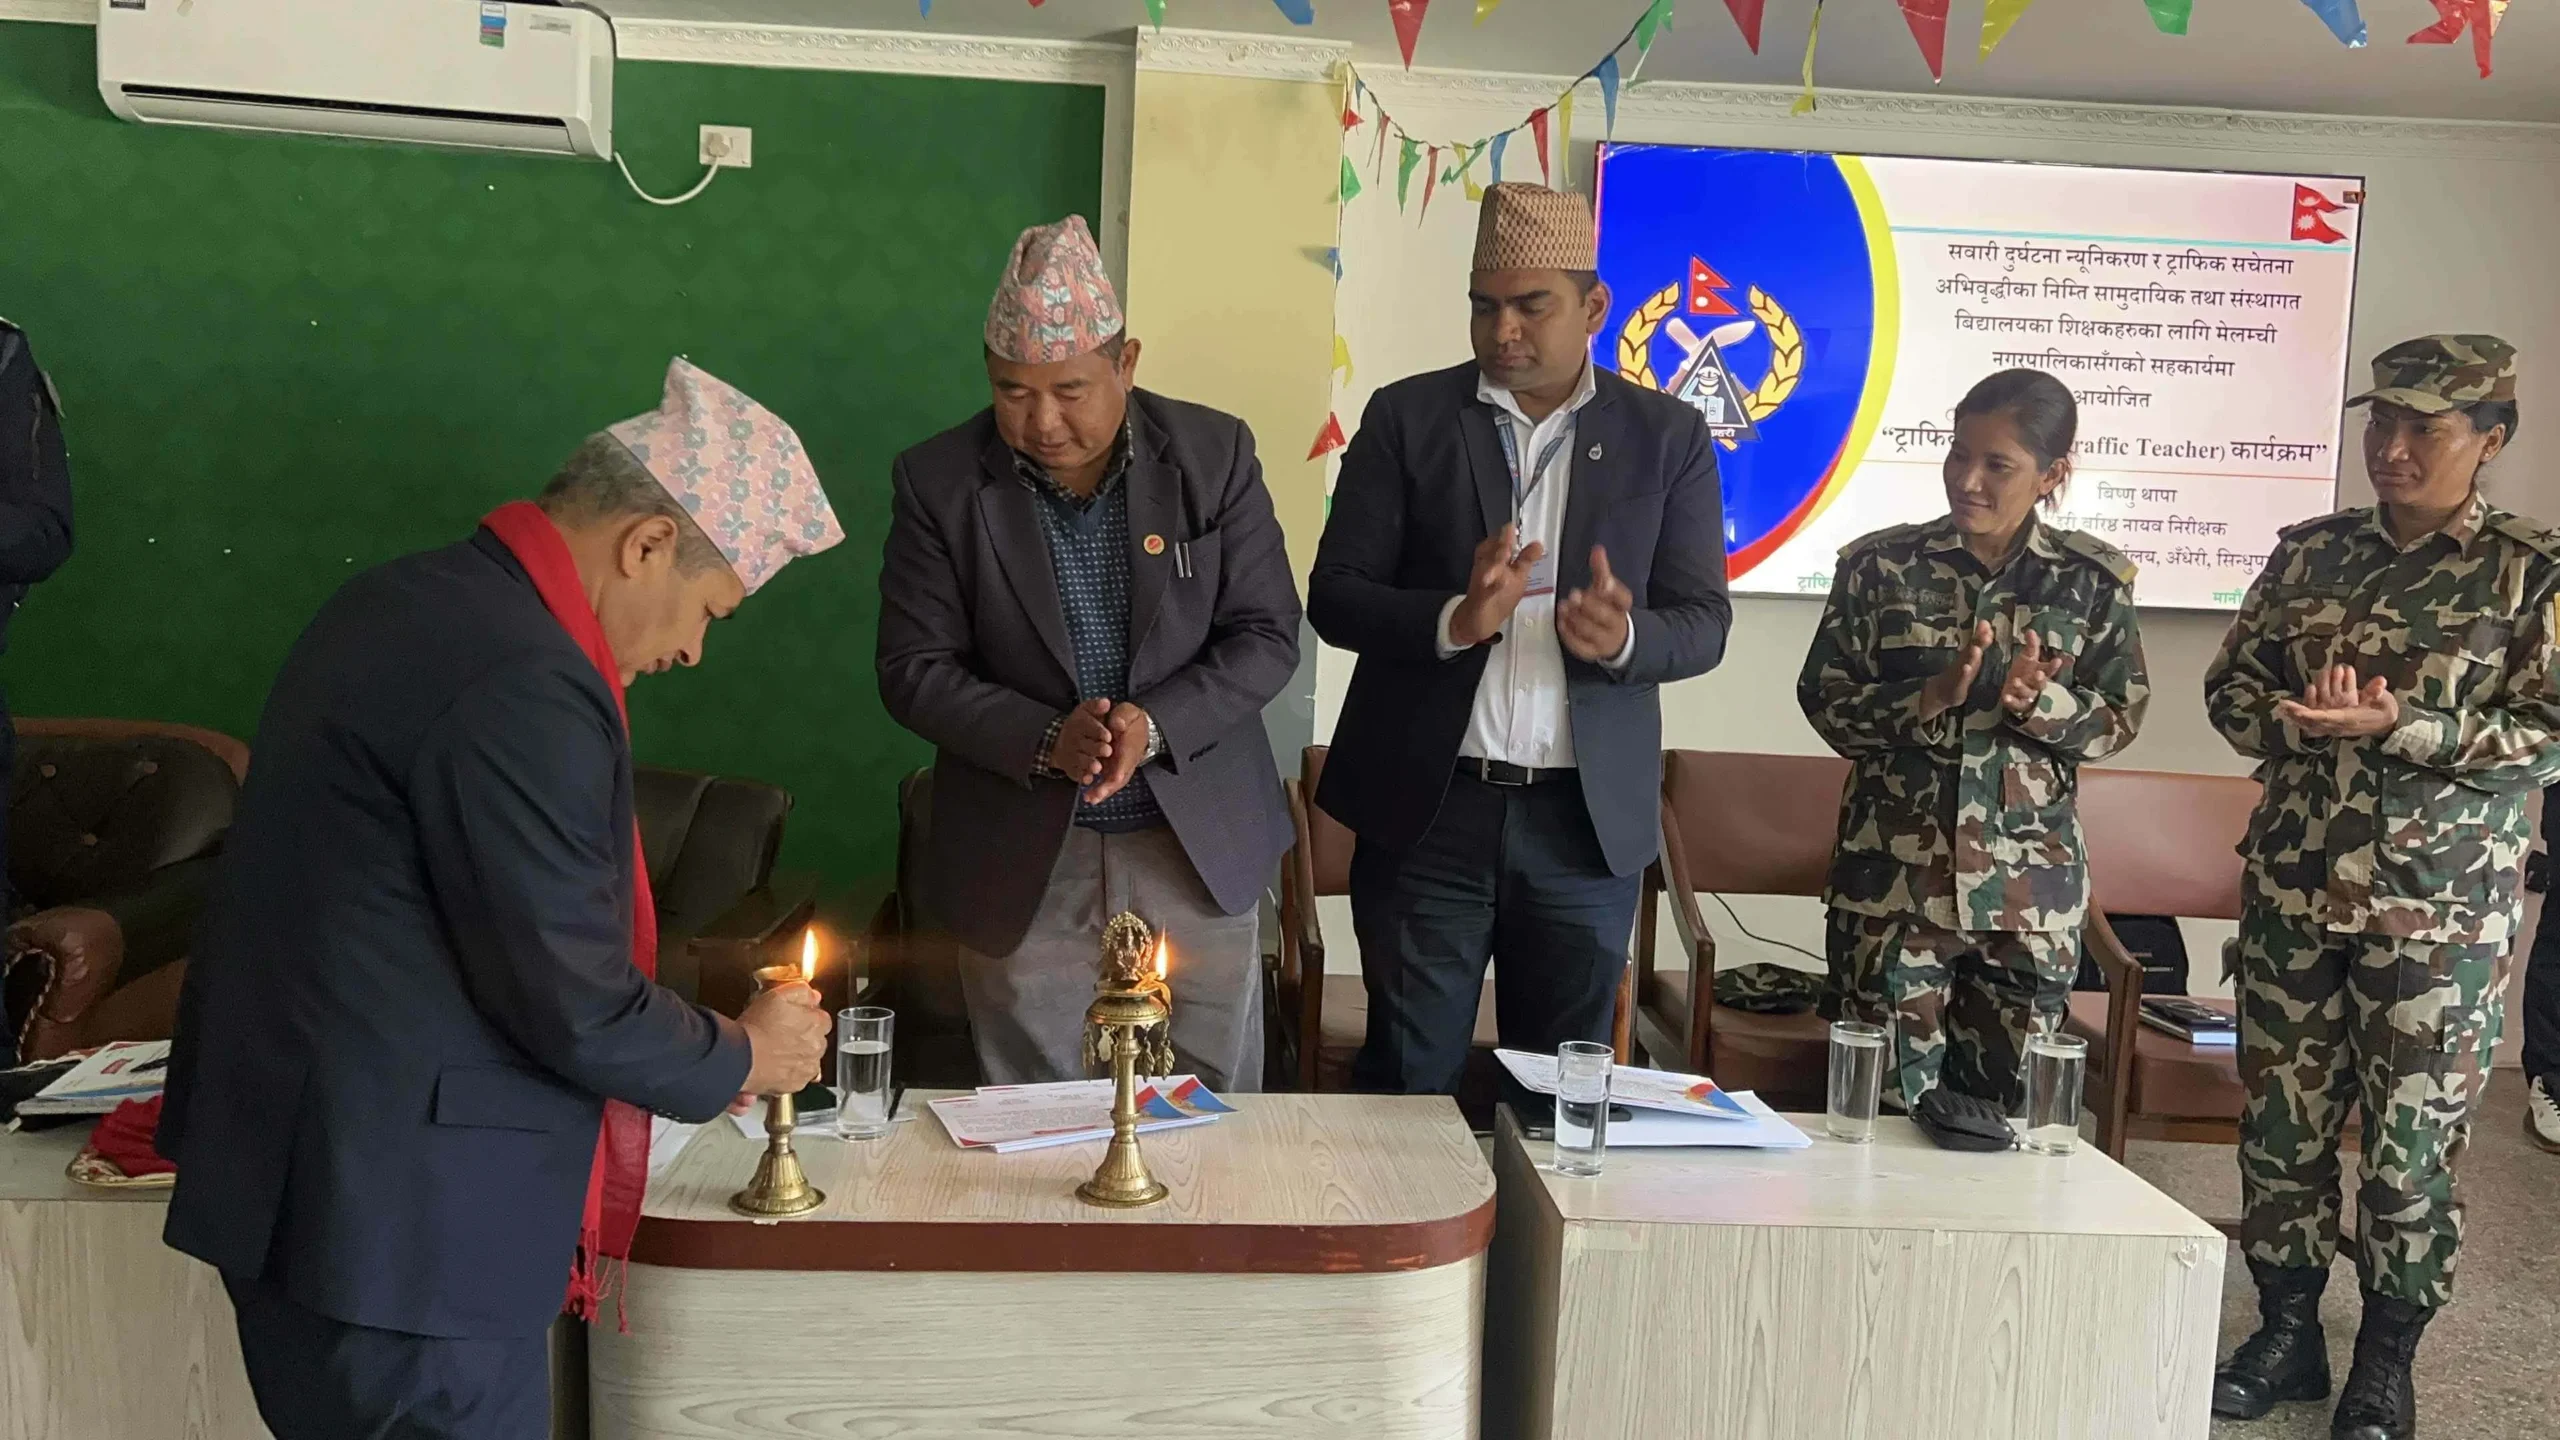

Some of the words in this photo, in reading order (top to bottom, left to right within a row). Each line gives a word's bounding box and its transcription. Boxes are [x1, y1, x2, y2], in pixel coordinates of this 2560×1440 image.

[1948, 241, 2000, 261] सवारी
[2003, 241, 2062, 272] दुर्घटना
[2066, 244, 2148, 273] न्यूनिकरण
[2152, 253, 2162, 269] र
[2166, 249, 2227, 275] ट्राफिक
[2232, 251, 2294, 274] सचेतना
[1936, 273, 2038, 304] अभिवृद्धीका
[2043, 277, 2089, 300] निम्ति
[2094, 282, 2186, 310] सामुदायिक
[2190, 290, 2225, 306] तथा
[2230, 289, 2302, 310] संस्थागत
[1955, 309, 2053, 333] बिद्यालयका
[2058, 313, 2162, 339] शिक्षकहरुका
[2167, 319, 2211, 341] लागि
[2216, 320, 2278, 343] मेलम्ची
[1992, 347, 2146, 373] नगरपालिकासँगको
[2150, 355, 2235, 377] सहकार्यमा
[2073, 385, 2152, 408] आयोजित
[2074, 436, 2129, 456] raffic
[2136, 438, 2225, 463] Teacher)
[2141, 488, 2178, 503] थापा
[2168, 514, 2228, 536] निरीक्षक
